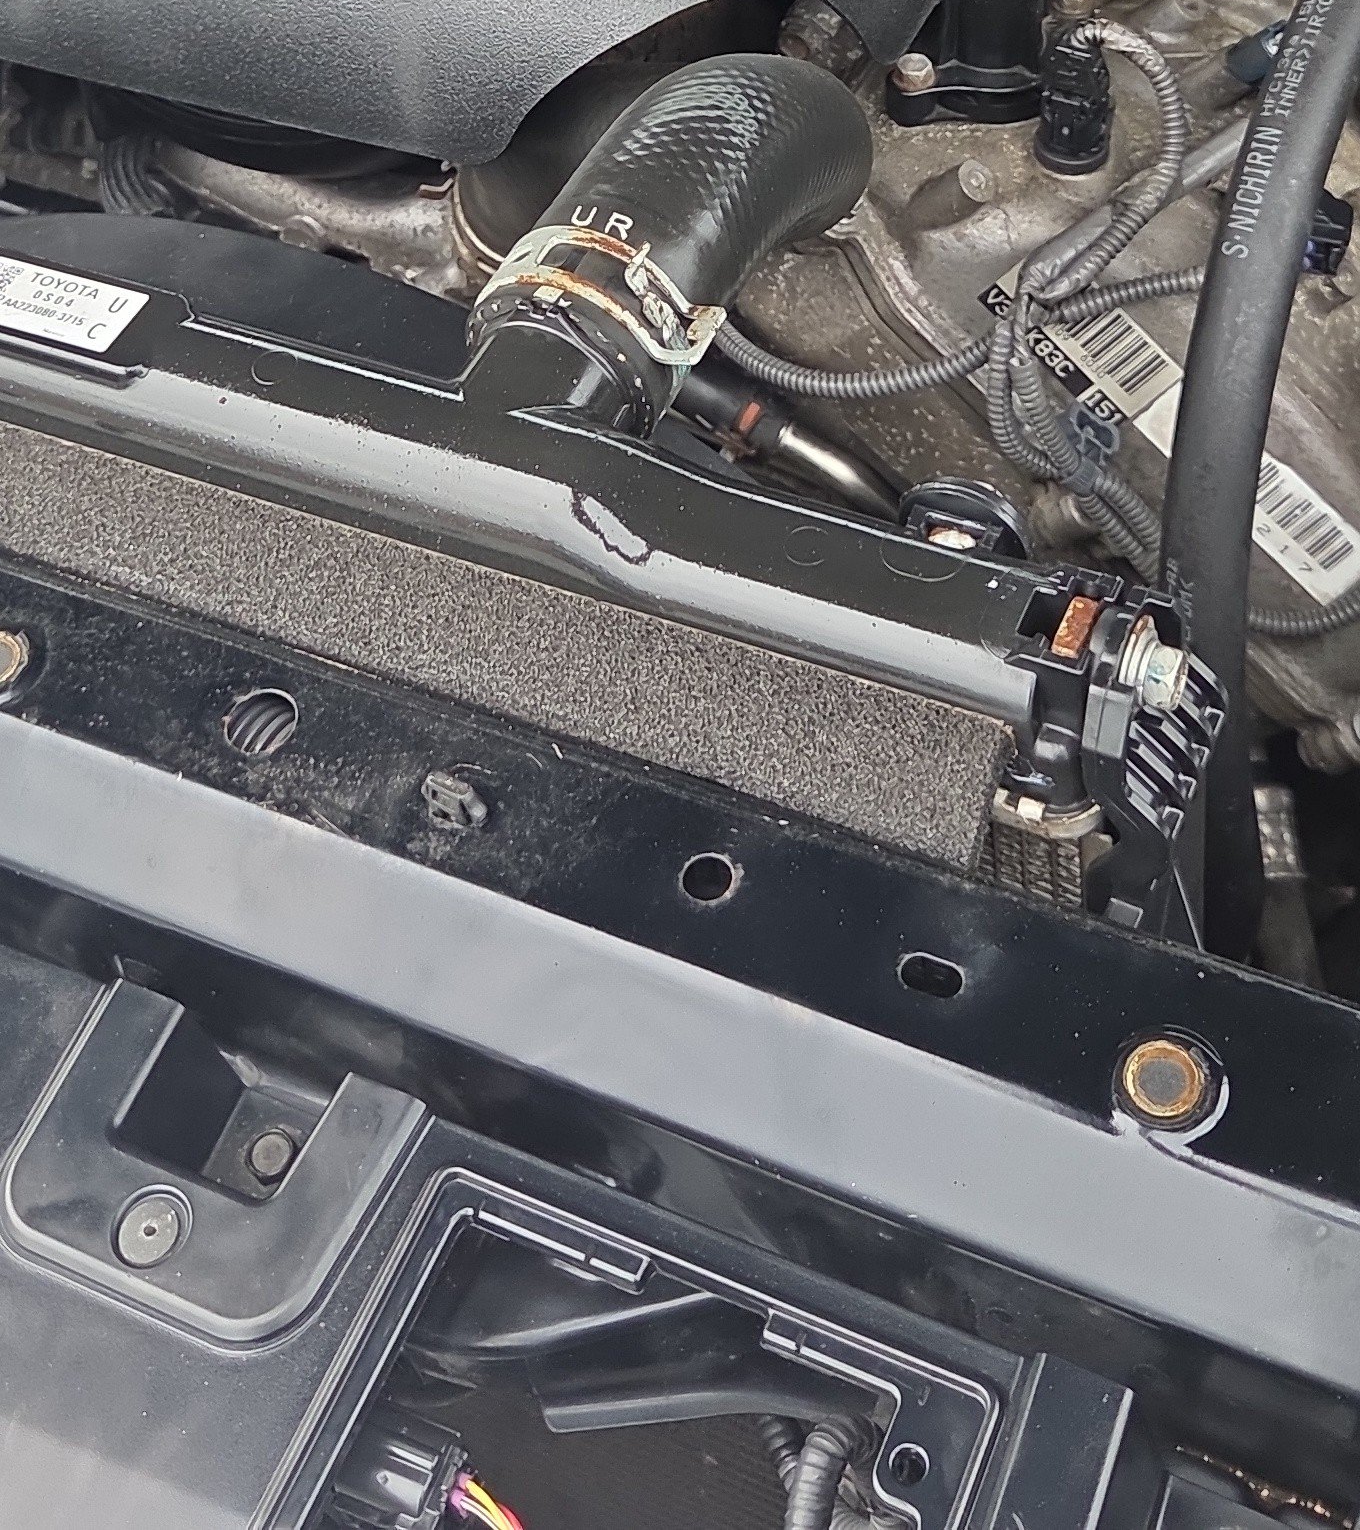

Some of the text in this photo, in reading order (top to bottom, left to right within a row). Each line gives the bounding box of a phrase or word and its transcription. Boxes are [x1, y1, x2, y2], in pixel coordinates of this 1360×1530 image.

[30, 271, 100, 300] TOYOTA
[107, 296, 129, 314] U
[86, 322, 108, 340] C
